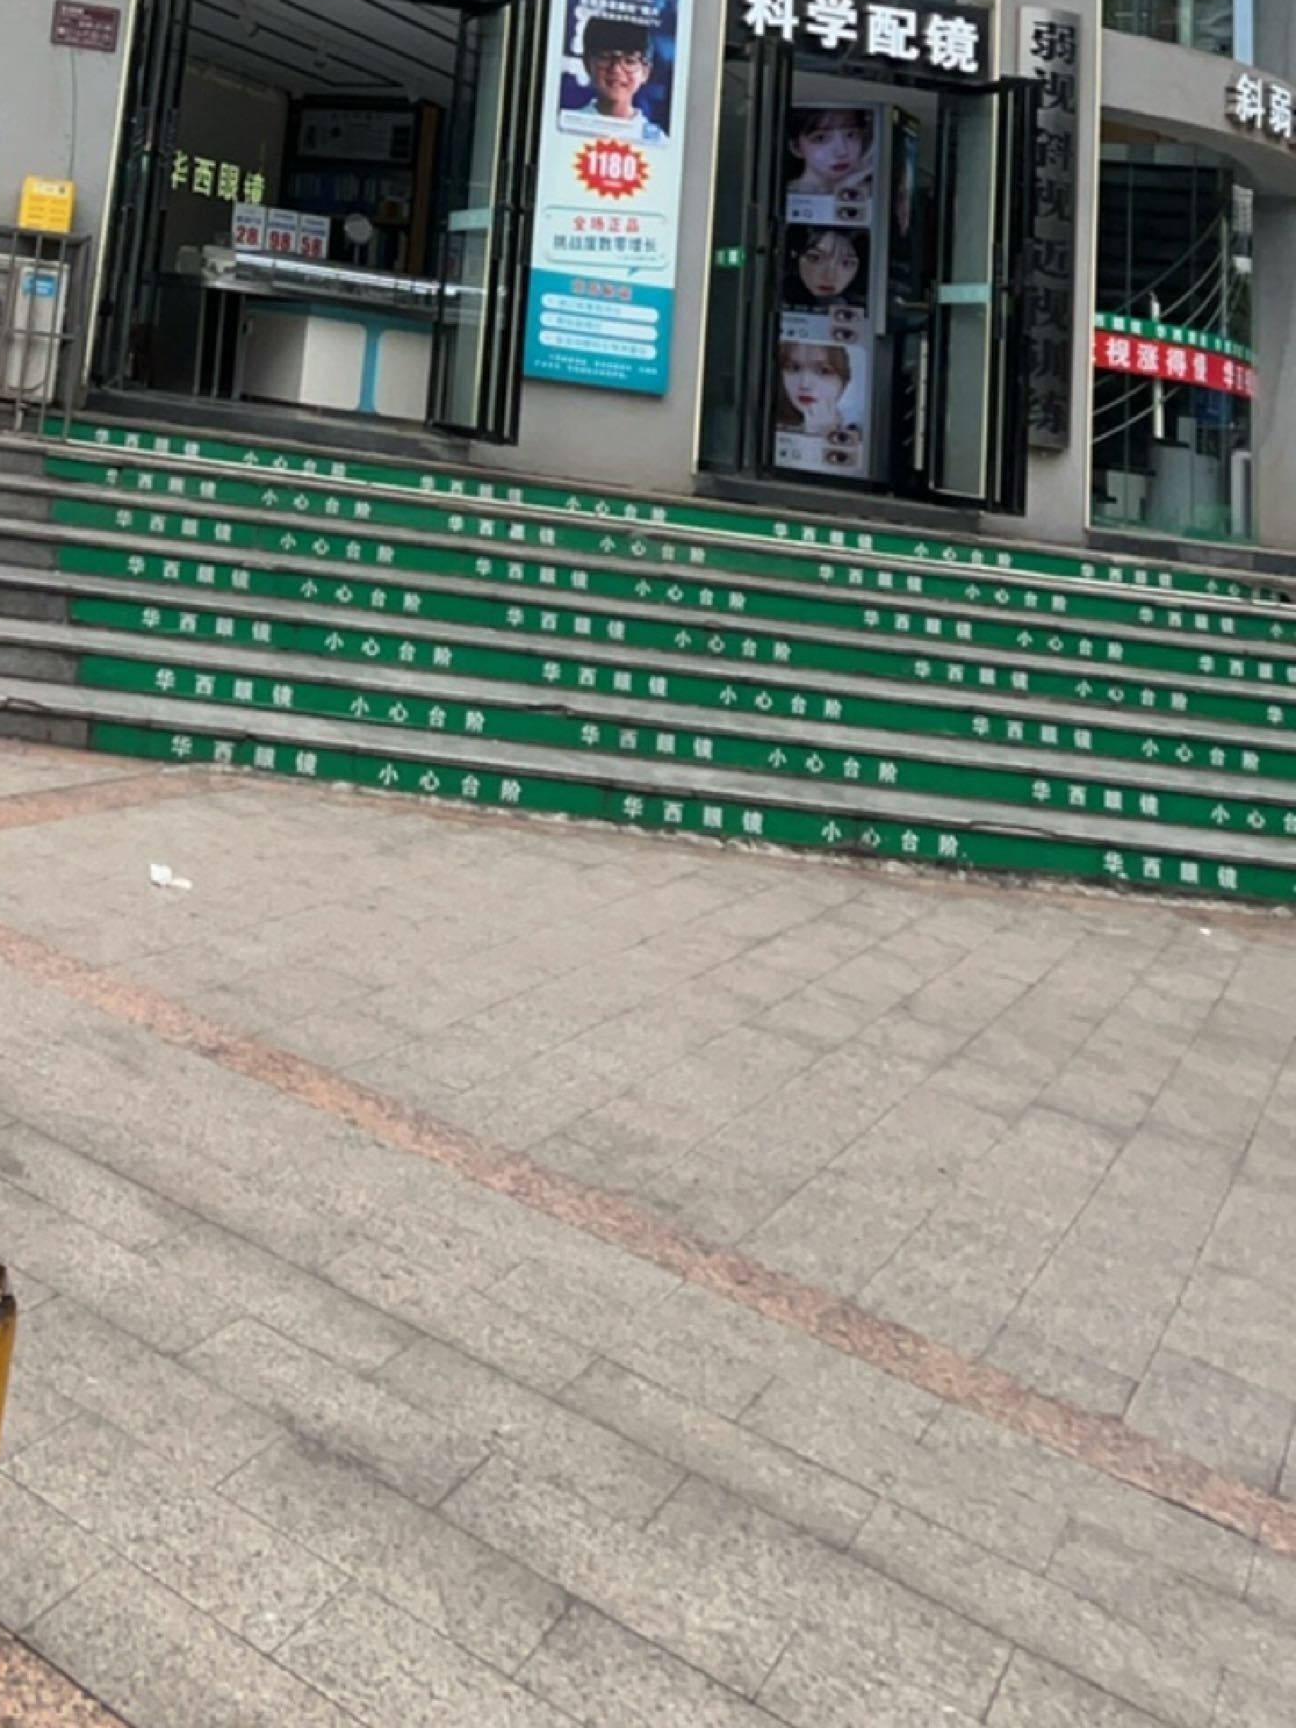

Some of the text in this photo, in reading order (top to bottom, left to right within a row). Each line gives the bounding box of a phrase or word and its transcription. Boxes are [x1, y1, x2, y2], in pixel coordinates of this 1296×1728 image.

[142, 607, 271, 643] 华西眼镜
[325, 631, 453, 668] 小心台阶
[543, 661, 668, 697] 华西眼镜
[720, 686, 842, 719] 小心台阶
[156, 668, 293, 707] 华西眼镜
[350, 696, 485, 733] 小心台阶
[581, 723, 713, 760] 华西眼镜
[768, 748, 898, 784] 小心台阶
[171, 735, 318, 776] 华西眼镜
[378, 763, 522, 803] 小心台阶
[623, 796, 764, 835] 华西眼镜
[821, 821, 958, 857] 小心台阶
